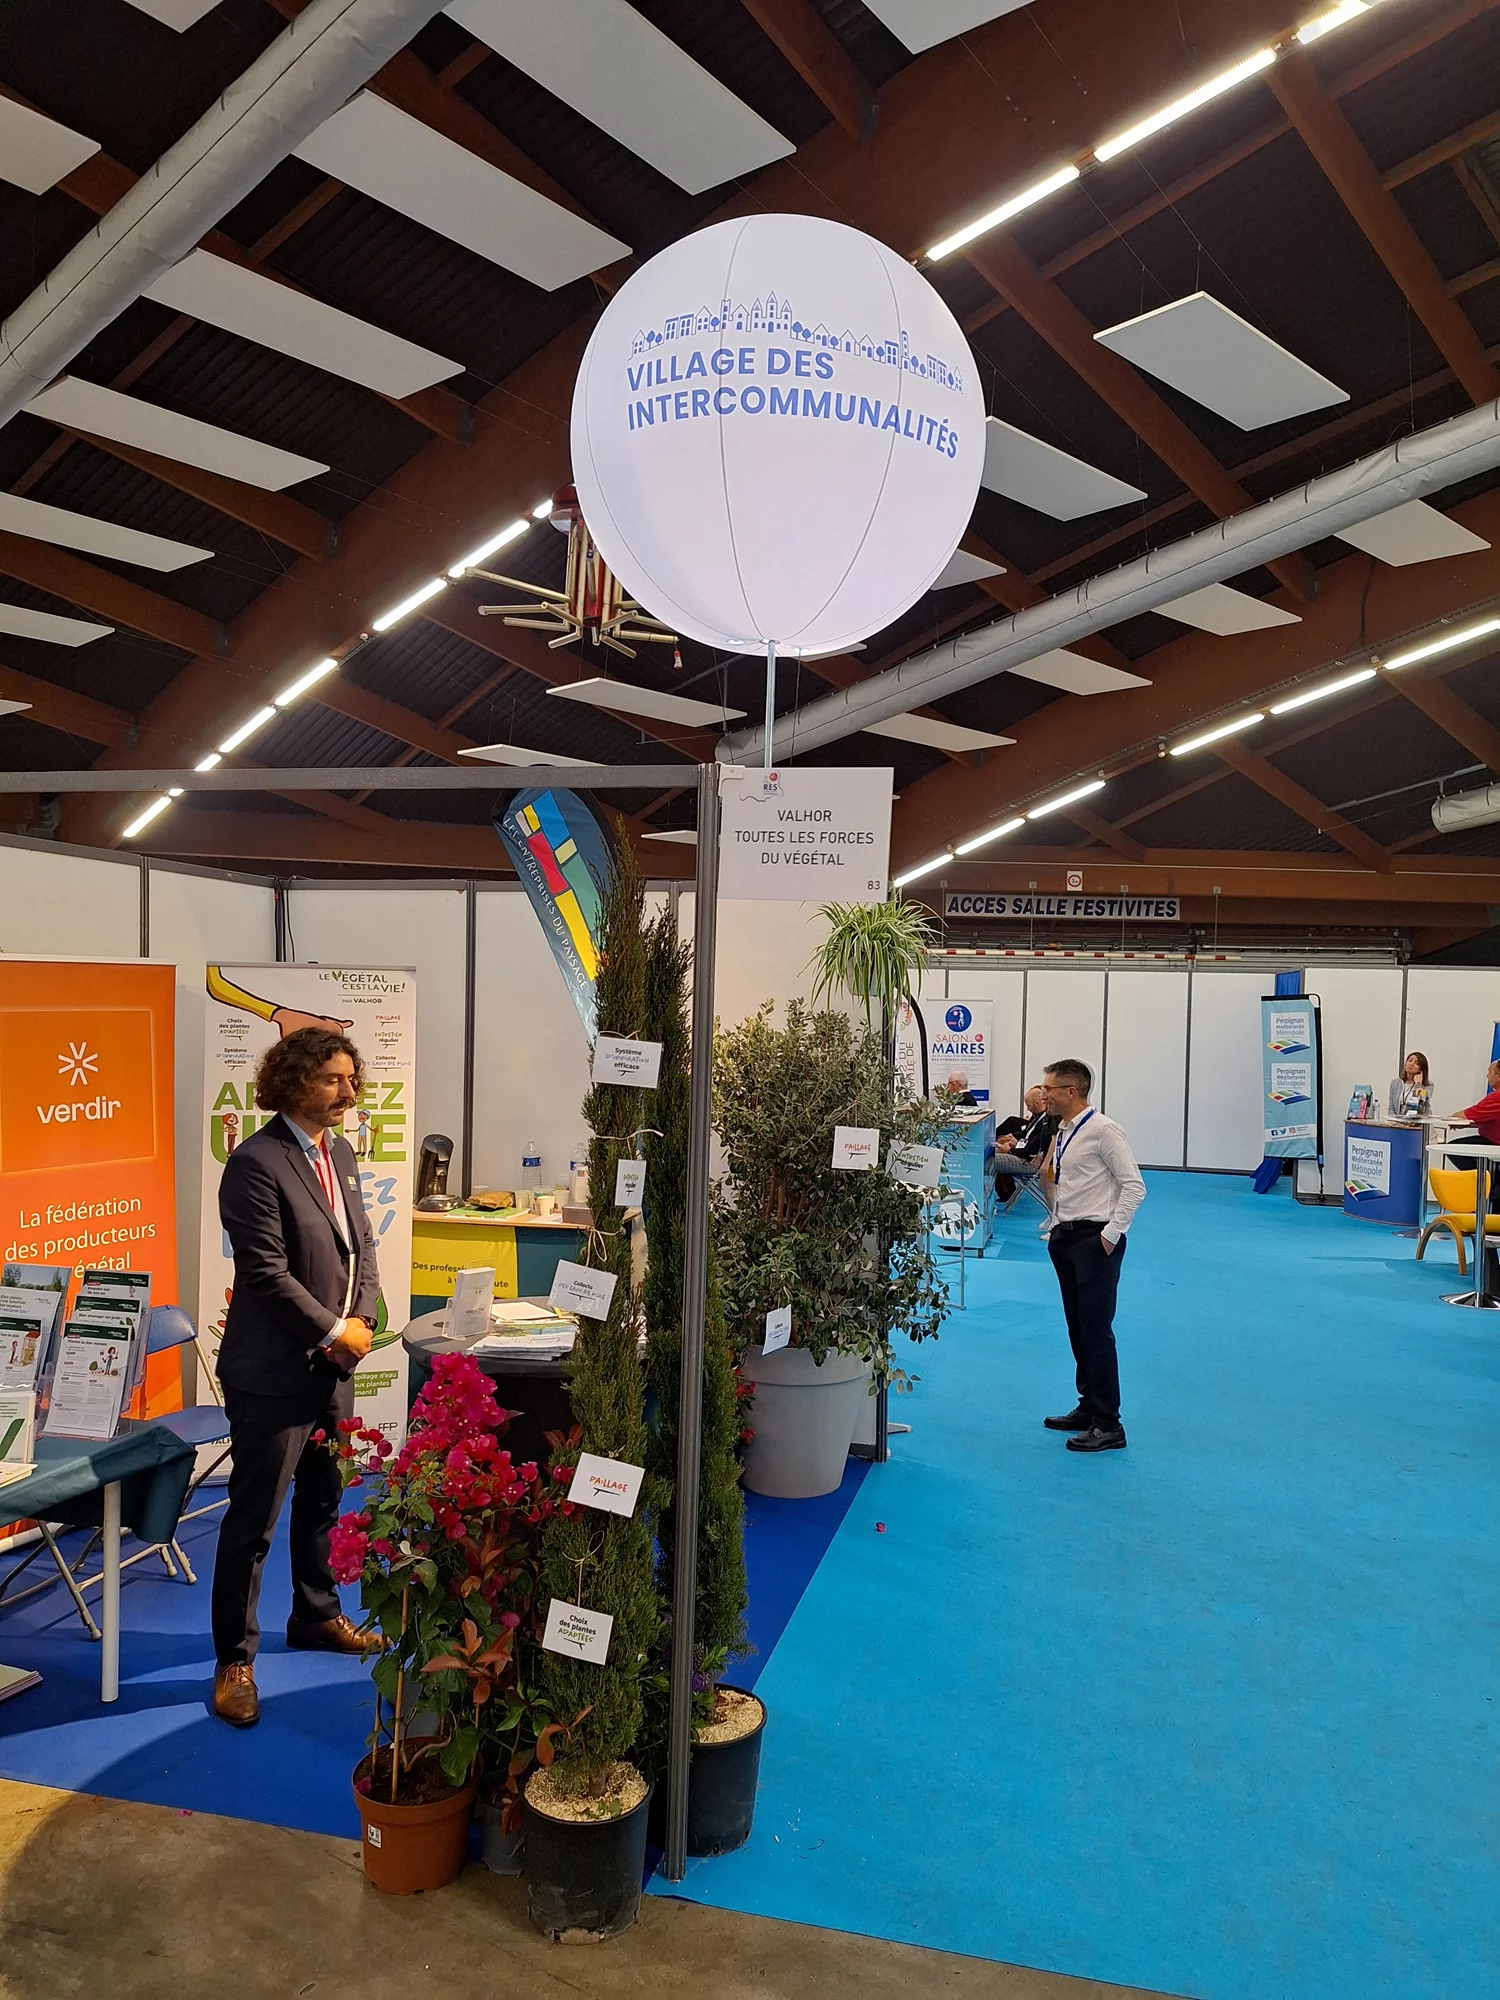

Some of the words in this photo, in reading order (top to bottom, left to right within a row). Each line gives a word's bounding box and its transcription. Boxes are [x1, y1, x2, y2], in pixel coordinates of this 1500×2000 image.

[626, 347, 756, 392] VILLAGE
[767, 348, 834, 380] DES
[627, 386, 960, 459] INTERCOMMUNALITÉS
[763, 783, 778, 791] RES
[777, 809, 832, 822] VALHOR
[734, 830, 785, 843] TOUTES
[789, 831, 815, 843] LES
[820, 831, 874, 844] FORCES
[761, 852, 779, 864] DU
[783, 849, 845, 865] VÉGÉTAL
[867, 880, 881, 890] 83
[503, 817, 520, 838] LES
[518, 840, 557, 915] ENTREPRISES
[552, 916, 566, 936] DU
[561, 938, 587, 989] PAYSAGE
[948, 896, 1006, 914] ACCES
[1011, 897, 1067, 915] SALLE
[1072, 898, 1177, 918] FESTIVITES
[319, 973, 330, 981] LE
[332, 970, 388, 983] VÉGÉTAL
[342, 983, 365, 991] C'EST
[1276, 1017, 1304, 1025] Perpignan
[936, 1033, 969, 1043] SALON
[614, 1047, 643, 1056] Système
[932, 1043, 985, 1055] MAIRES
[613, 1062, 640, 1070] efficace
[1277, 1068, 1306, 1076] Perpignan
[36, 1095, 121, 1124] verdir
[1352, 1145, 1384, 1158] Perpignan
[1352, 1155, 1384, 1167] Méditerranée
[1352, 1163, 1383, 1177] Métropole
[20, 1209, 41, 1229] La
[45, 1197, 141, 1226] fédération
[4, 1240, 39, 1262] des
[43, 1222, 156, 1259] producteurs
[73, 1251, 131, 1280] égétal
[412, 1261, 428, 1270] Des
[430, 1262, 467, 1273] professi
[366, 1380, 390, 1388] plantes
[588, 1475, 629, 1493] PAILLAGE
[569, 1614, 588, 1625] Choix
[559, 1618, 571, 1629] des
[571, 1623, 597, 1636] plantes
[557, 1627, 595, 1643] ADAPTÉES
